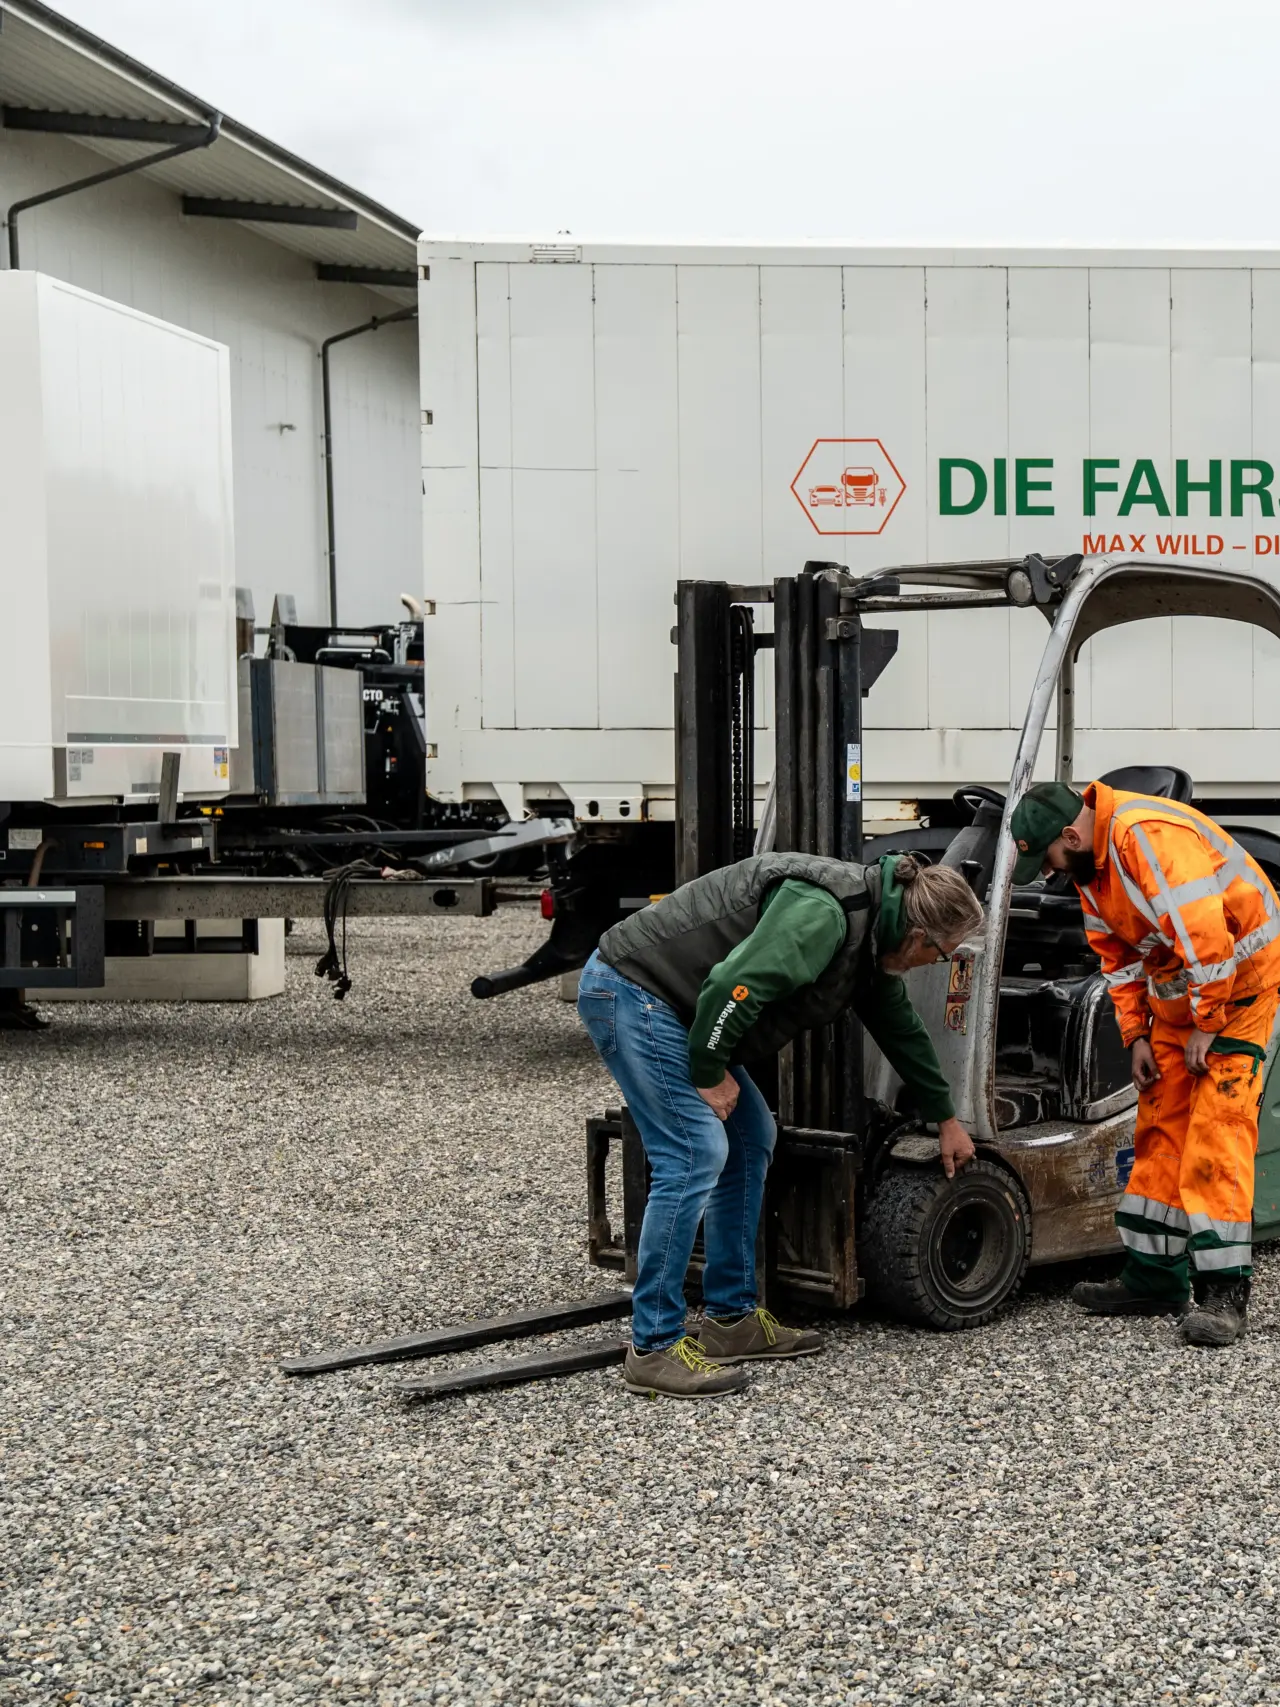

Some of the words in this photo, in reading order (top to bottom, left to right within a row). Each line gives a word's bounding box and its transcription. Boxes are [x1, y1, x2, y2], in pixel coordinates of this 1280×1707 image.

[939, 458, 1054, 515] DIE
[1082, 534, 1145, 555] MAX
[1155, 534, 1224, 556] WILD
[716, 999, 738, 1026] Max
[706, 1025, 724, 1051] Wild
